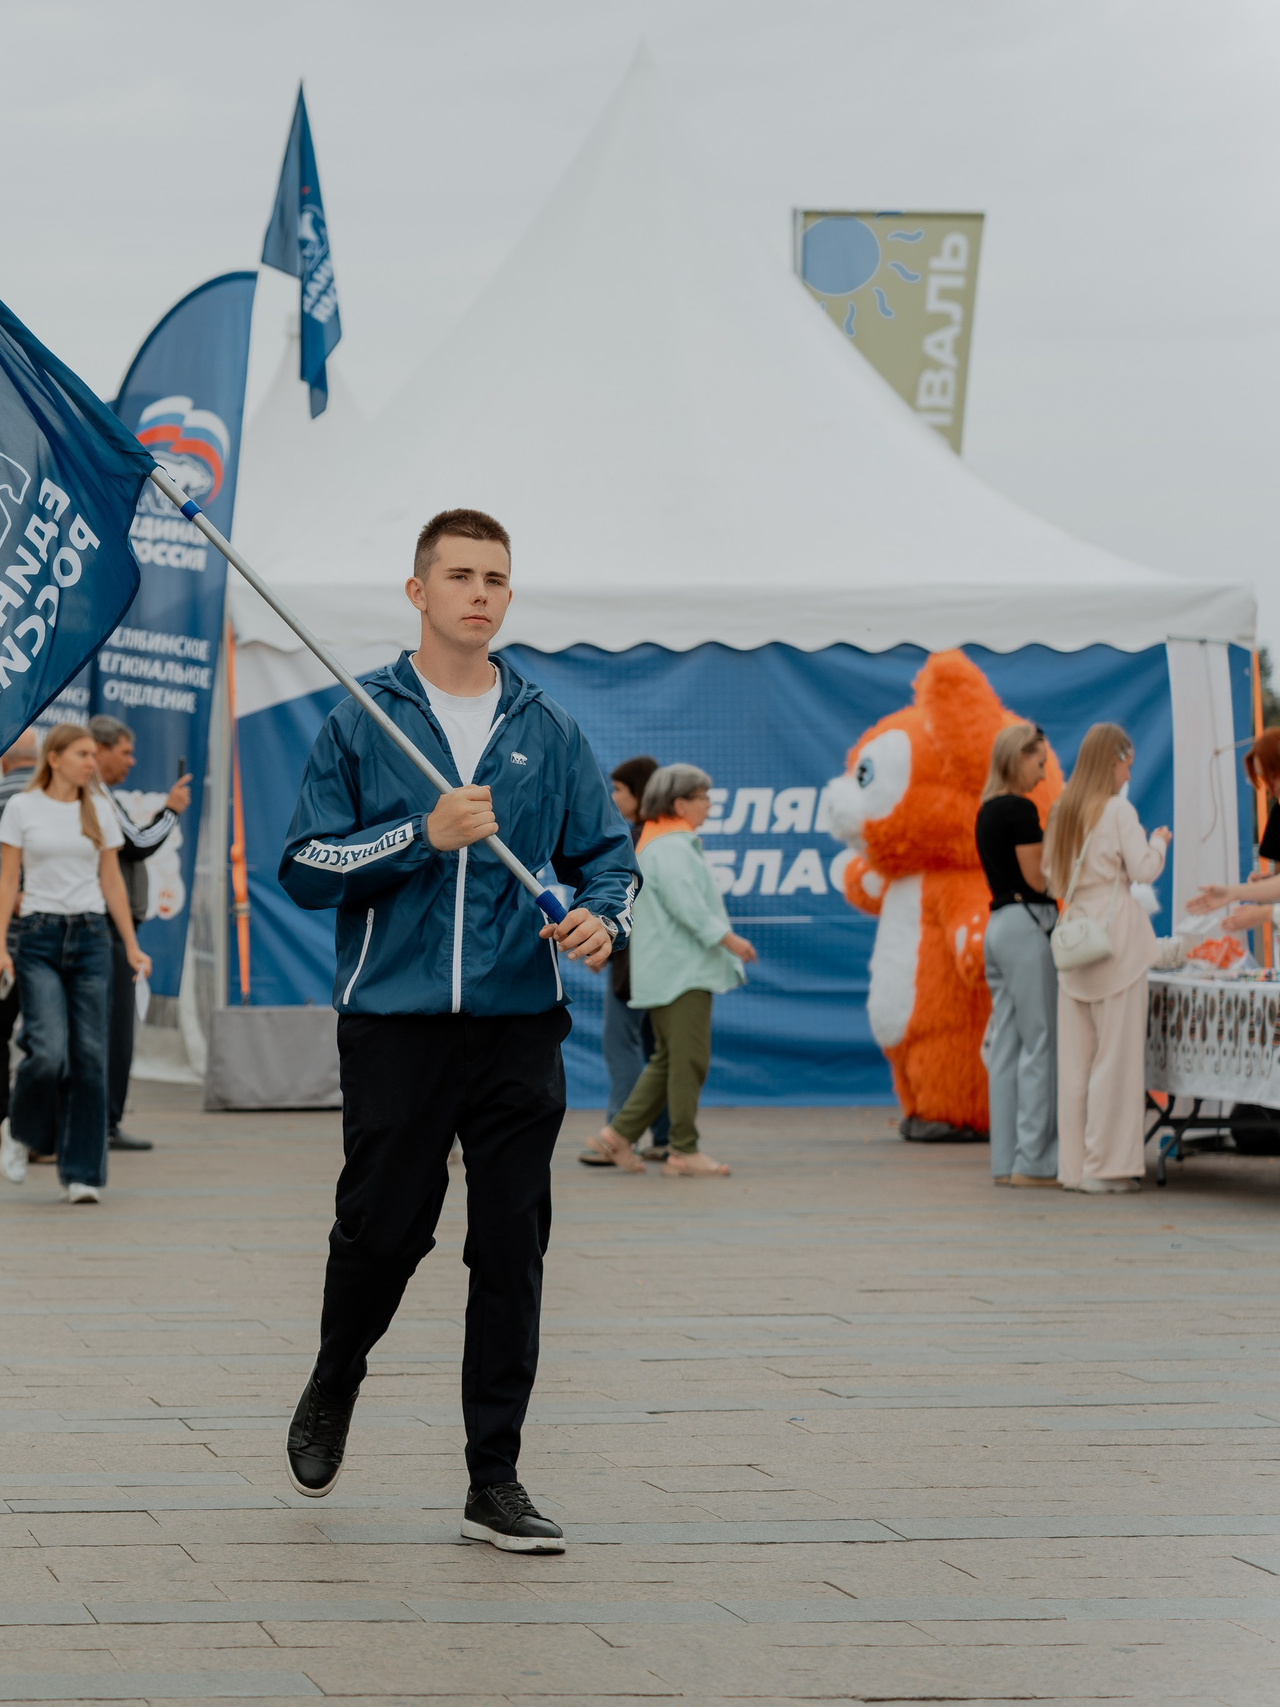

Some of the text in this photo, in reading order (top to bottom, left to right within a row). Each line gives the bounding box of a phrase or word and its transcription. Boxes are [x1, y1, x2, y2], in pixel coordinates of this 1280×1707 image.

[106, 626, 210, 662] ЕЛЯБИНСКОЕ
[97, 650, 212, 690] ЕГИОНАЛЬНОЕ
[696, 786, 832, 836] ЕЛЯ
